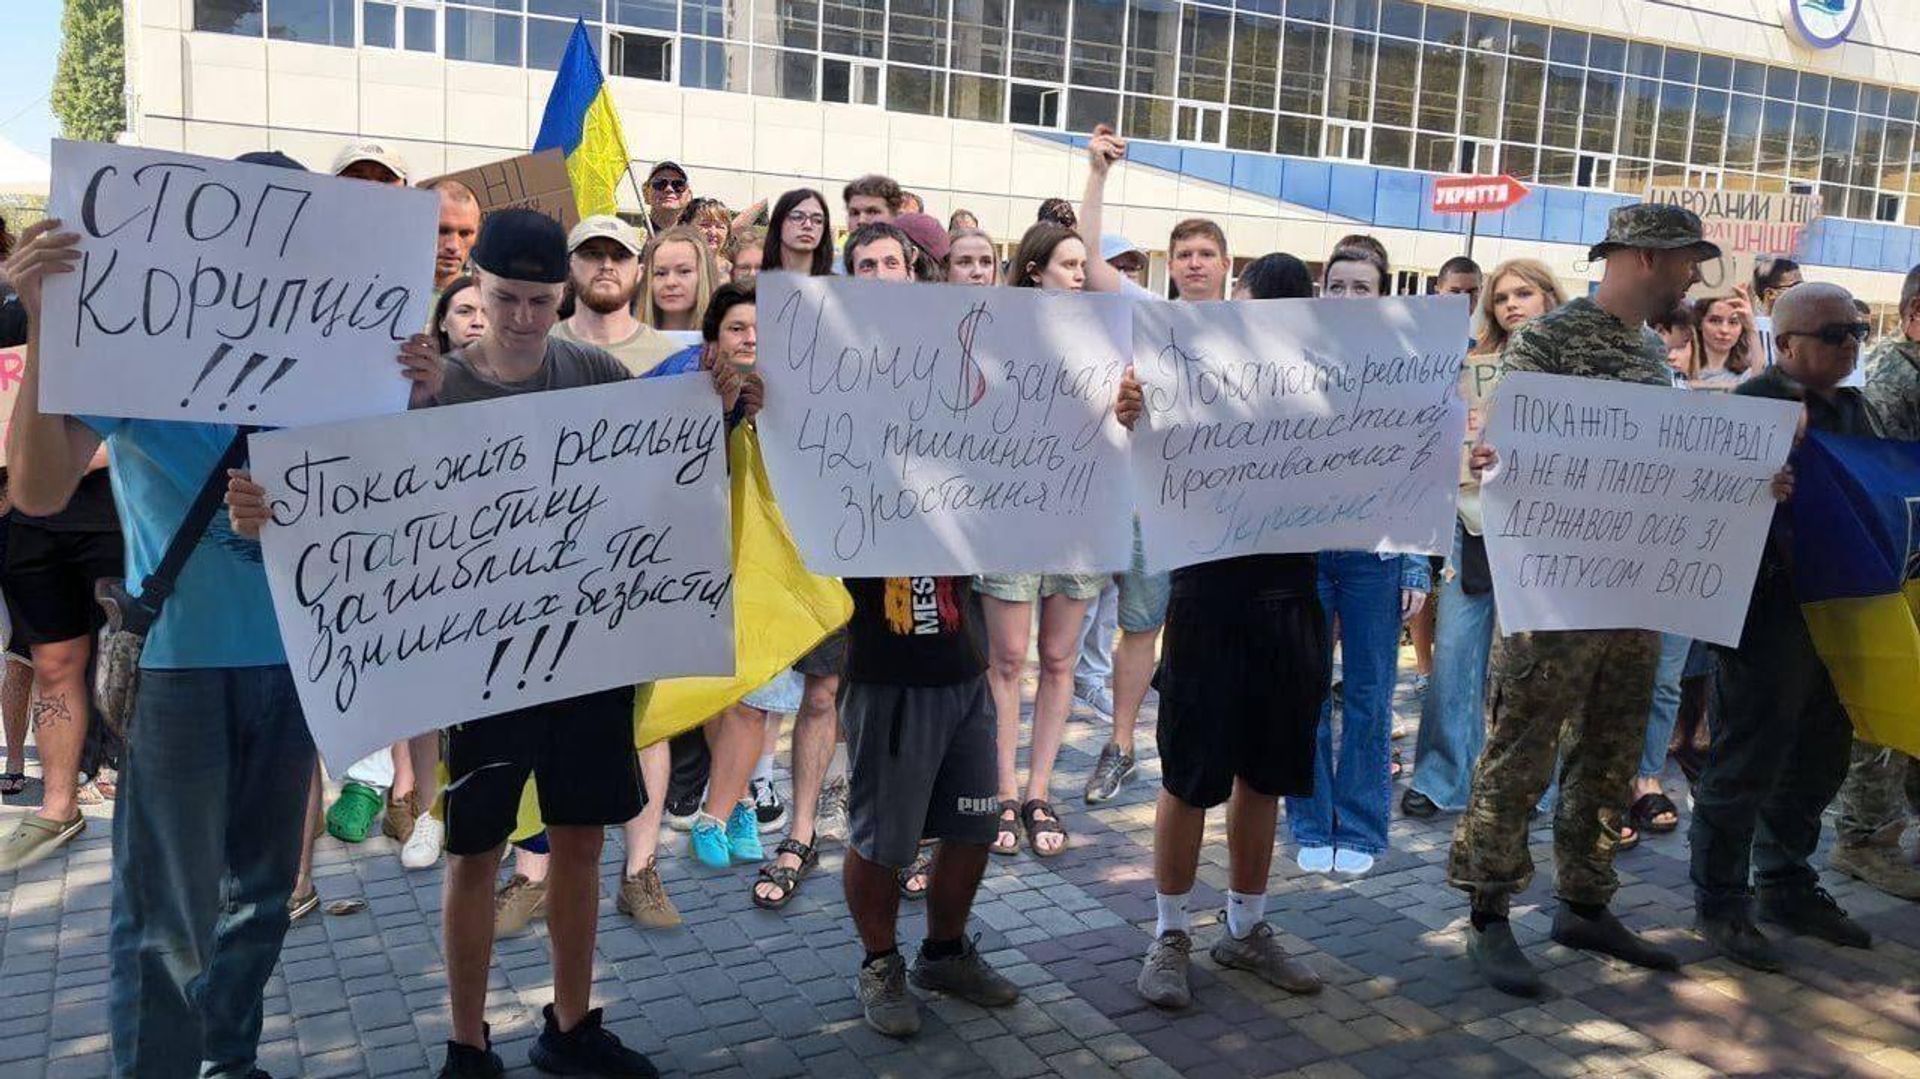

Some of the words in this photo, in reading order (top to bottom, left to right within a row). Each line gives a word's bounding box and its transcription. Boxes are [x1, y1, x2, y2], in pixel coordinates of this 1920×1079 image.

[81, 162, 312, 258] СТОП
[1435, 184, 1508, 204] УКРИТТЯ
[180, 342, 299, 412] !!!
[776, 289, 940, 421] Чому
[938, 301, 994, 423] $
[992, 355, 1121, 451] зараз
[1151, 327, 1357, 413] Покажіть
[1350, 352, 1463, 418] реальну
[797, 408, 872, 478] 42,
[1161, 401, 1451, 461] статистику
[1512, 394, 1640, 442] ПОКАЖІТЬ
[1657, 412, 1777, 461] НАСПРАВДІ
[270, 451, 530, 527] Покажіть
[552, 417, 722, 486] реальну
[1160, 446, 1406, 510] проживаючих
[1409, 432, 1442, 474] в
[1502, 448, 1519, 486] А
[1532, 452, 1561, 486] НЕ
[1563, 456, 1587, 491] НА
[1597, 459, 1676, 498] ПАПЕРІ
[1682, 467, 1771, 507] ЗАХИСТ
[1498, 499, 1632, 543] ДЕРЖАВОЮ
[1637, 514, 1690, 548] ОСІБ
[1698, 518, 1728, 552] ЗІ
[307, 540, 587, 683] загиблих
[594, 524, 672, 573] та
[913, 577, 939, 635] MES
[1518, 553, 1645, 590] СТАТУСОМ
[1656, 558, 1723, 600] ВПО
[334, 593, 566, 714] зниклих
[481, 620, 579, 700] !!!
